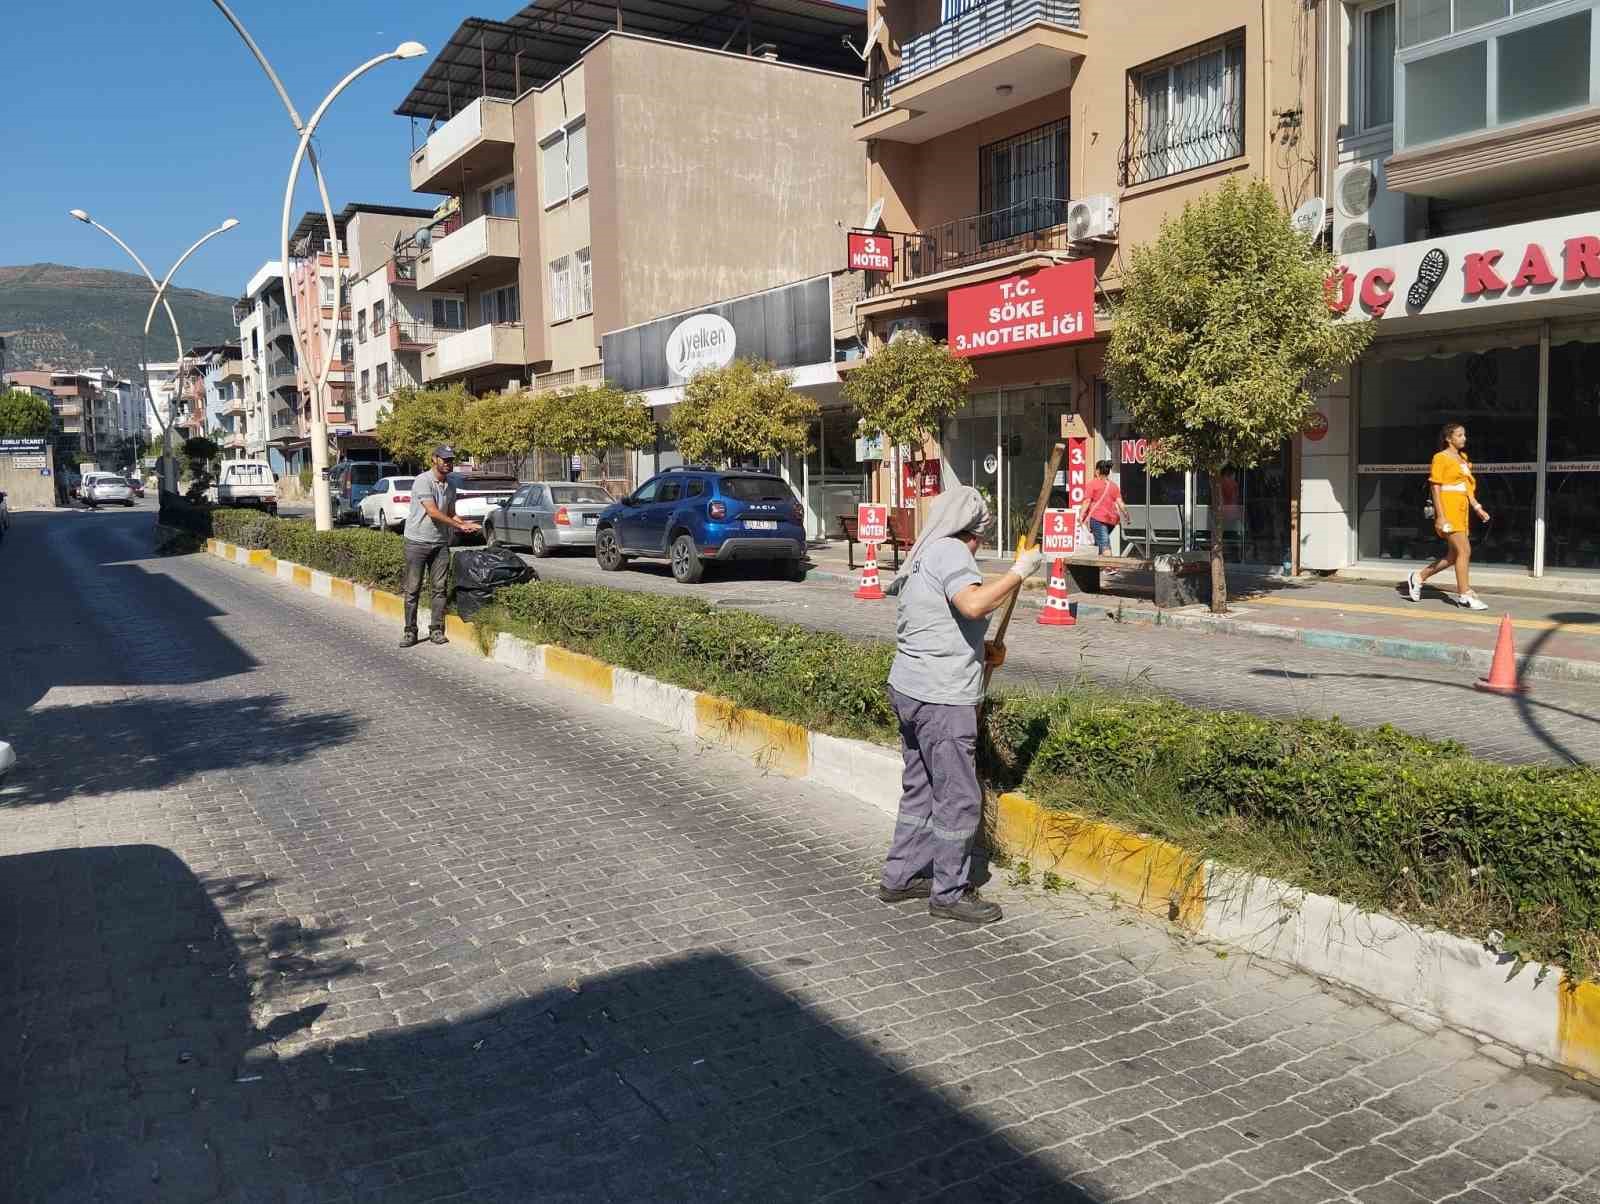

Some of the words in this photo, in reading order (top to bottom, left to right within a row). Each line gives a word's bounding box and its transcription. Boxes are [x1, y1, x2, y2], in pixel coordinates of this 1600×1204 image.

[864, 239, 881, 254] 3.
[853, 253, 889, 268] NOTER
[999, 279, 1036, 299] T.C.
[988, 299, 1045, 323] SÖKE
[955, 311, 1084, 351] 3.NOTERLİĞİ
[685, 326, 726, 361] yelken
[1071, 448, 1085, 465] 3.
[867, 509, 880, 523] 3.
[1053, 515, 1068, 532] 3.
[861, 524, 884, 536] NOTER
[1045, 535, 1073, 550] NOTER
